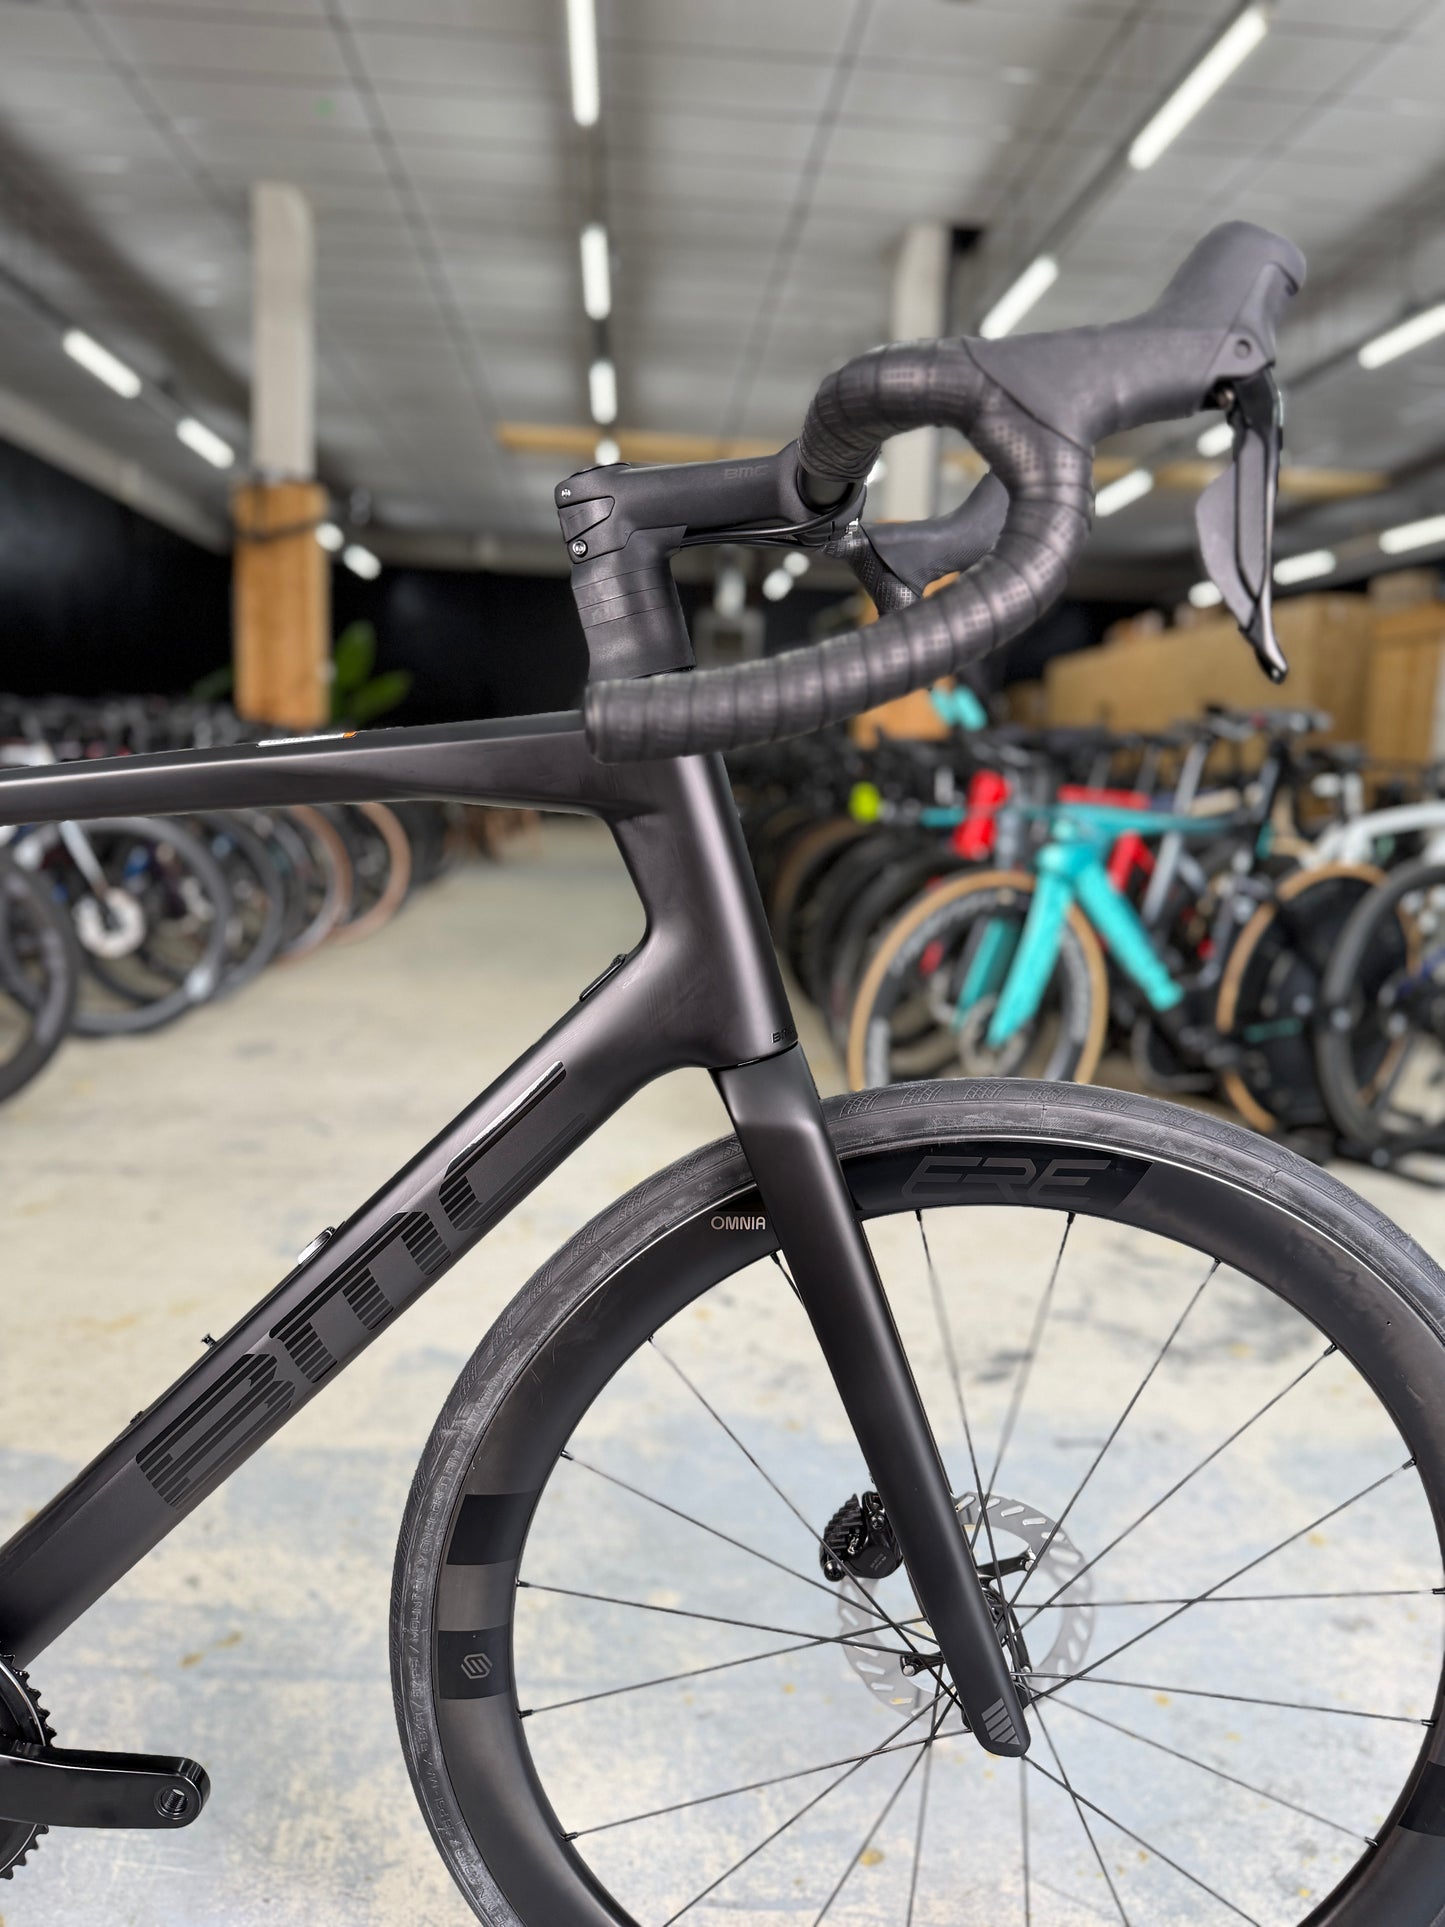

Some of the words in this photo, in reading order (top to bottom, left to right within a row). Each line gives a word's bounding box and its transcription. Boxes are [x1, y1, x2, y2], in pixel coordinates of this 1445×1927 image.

[724, 464, 769, 479] BMC
[902, 1155, 1111, 1204] ERE
[710, 1215, 766, 1231] OMNIA
[408, 1590, 423, 1642] MOUNT
